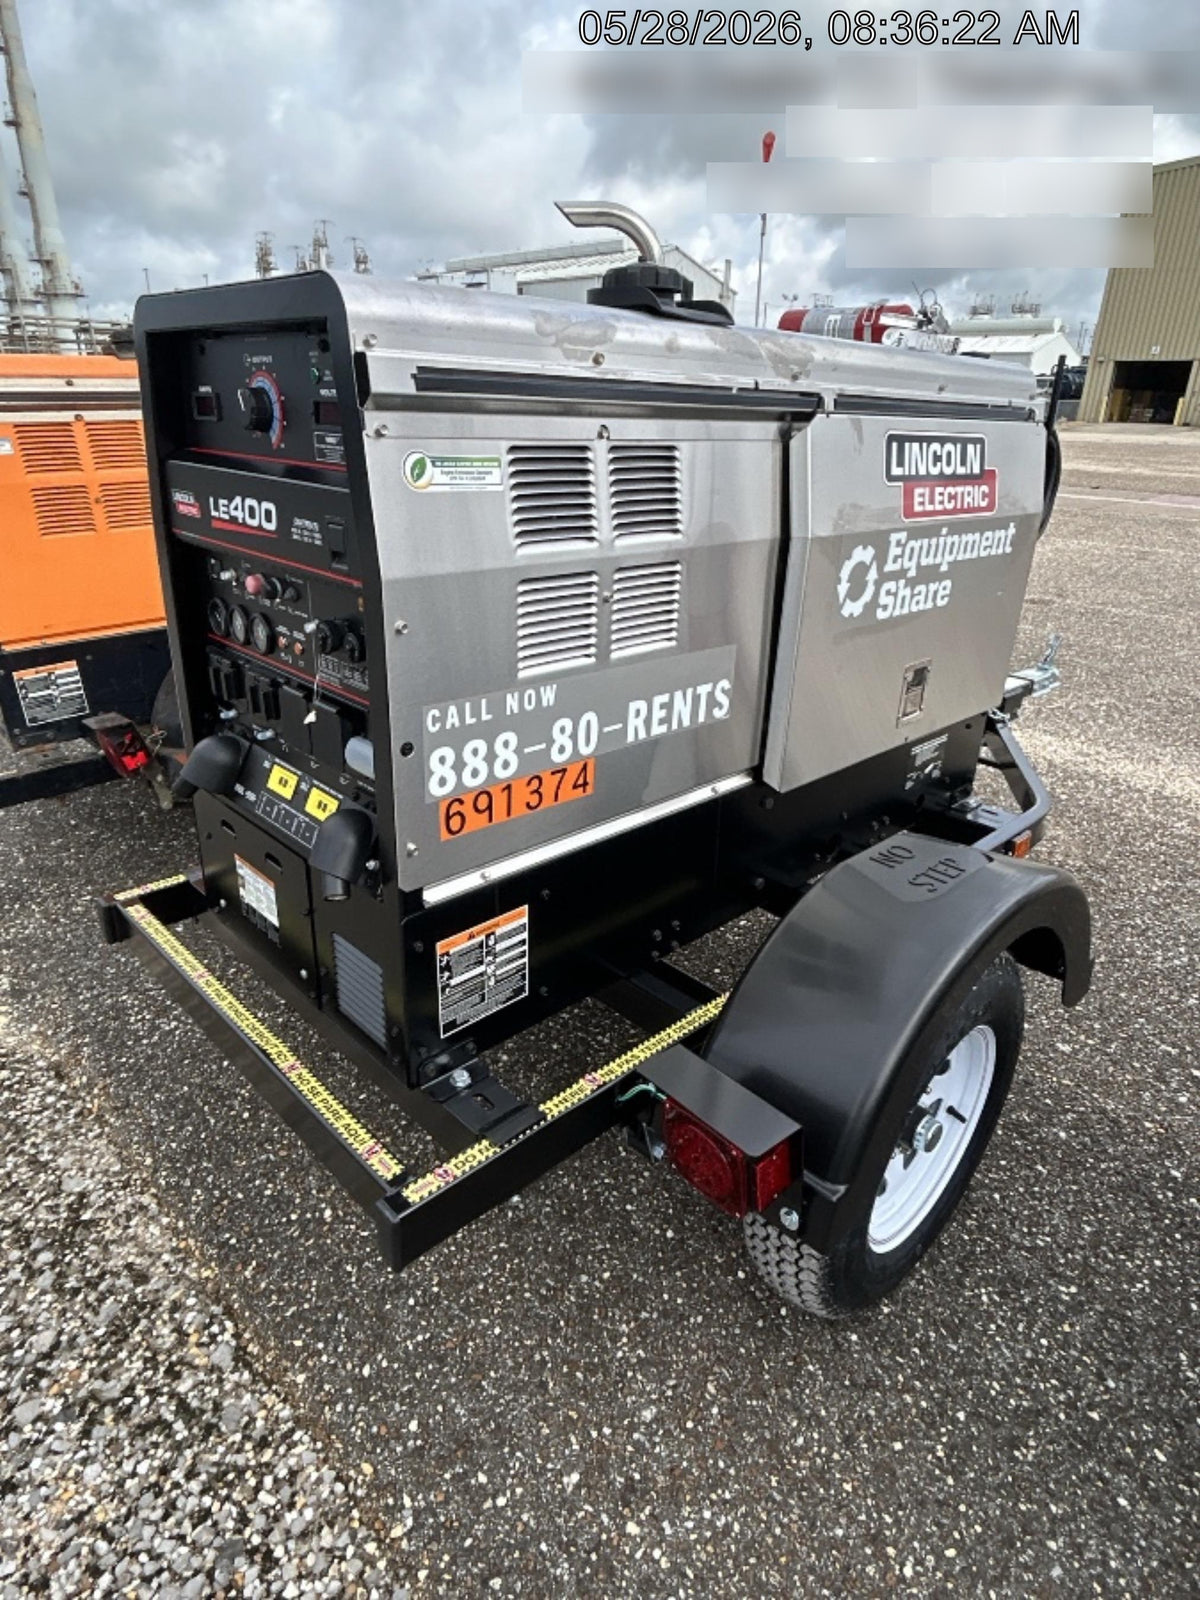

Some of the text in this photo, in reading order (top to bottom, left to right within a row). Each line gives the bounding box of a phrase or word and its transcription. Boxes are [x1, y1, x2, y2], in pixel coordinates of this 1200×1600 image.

[890, 441, 981, 477] LINCOLN
[209, 495, 277, 531] LE400
[913, 484, 990, 513] ELECTRIC
[884, 521, 1016, 578] Equipment
[876, 579, 953, 621] Share
[426, 684, 558, 734] CALL NOW
[428, 679, 732, 798] 888-80-RENTS
[444, 761, 590, 837] 691374
[869, 845, 916, 869] NO
[907, 857, 967, 894] STEP
[295, 1072, 312, 1087] NO
[307, 1085, 321, 1099] SE
[319, 1098, 346, 1123] PARE
[453, 1153, 477, 1171] DO
